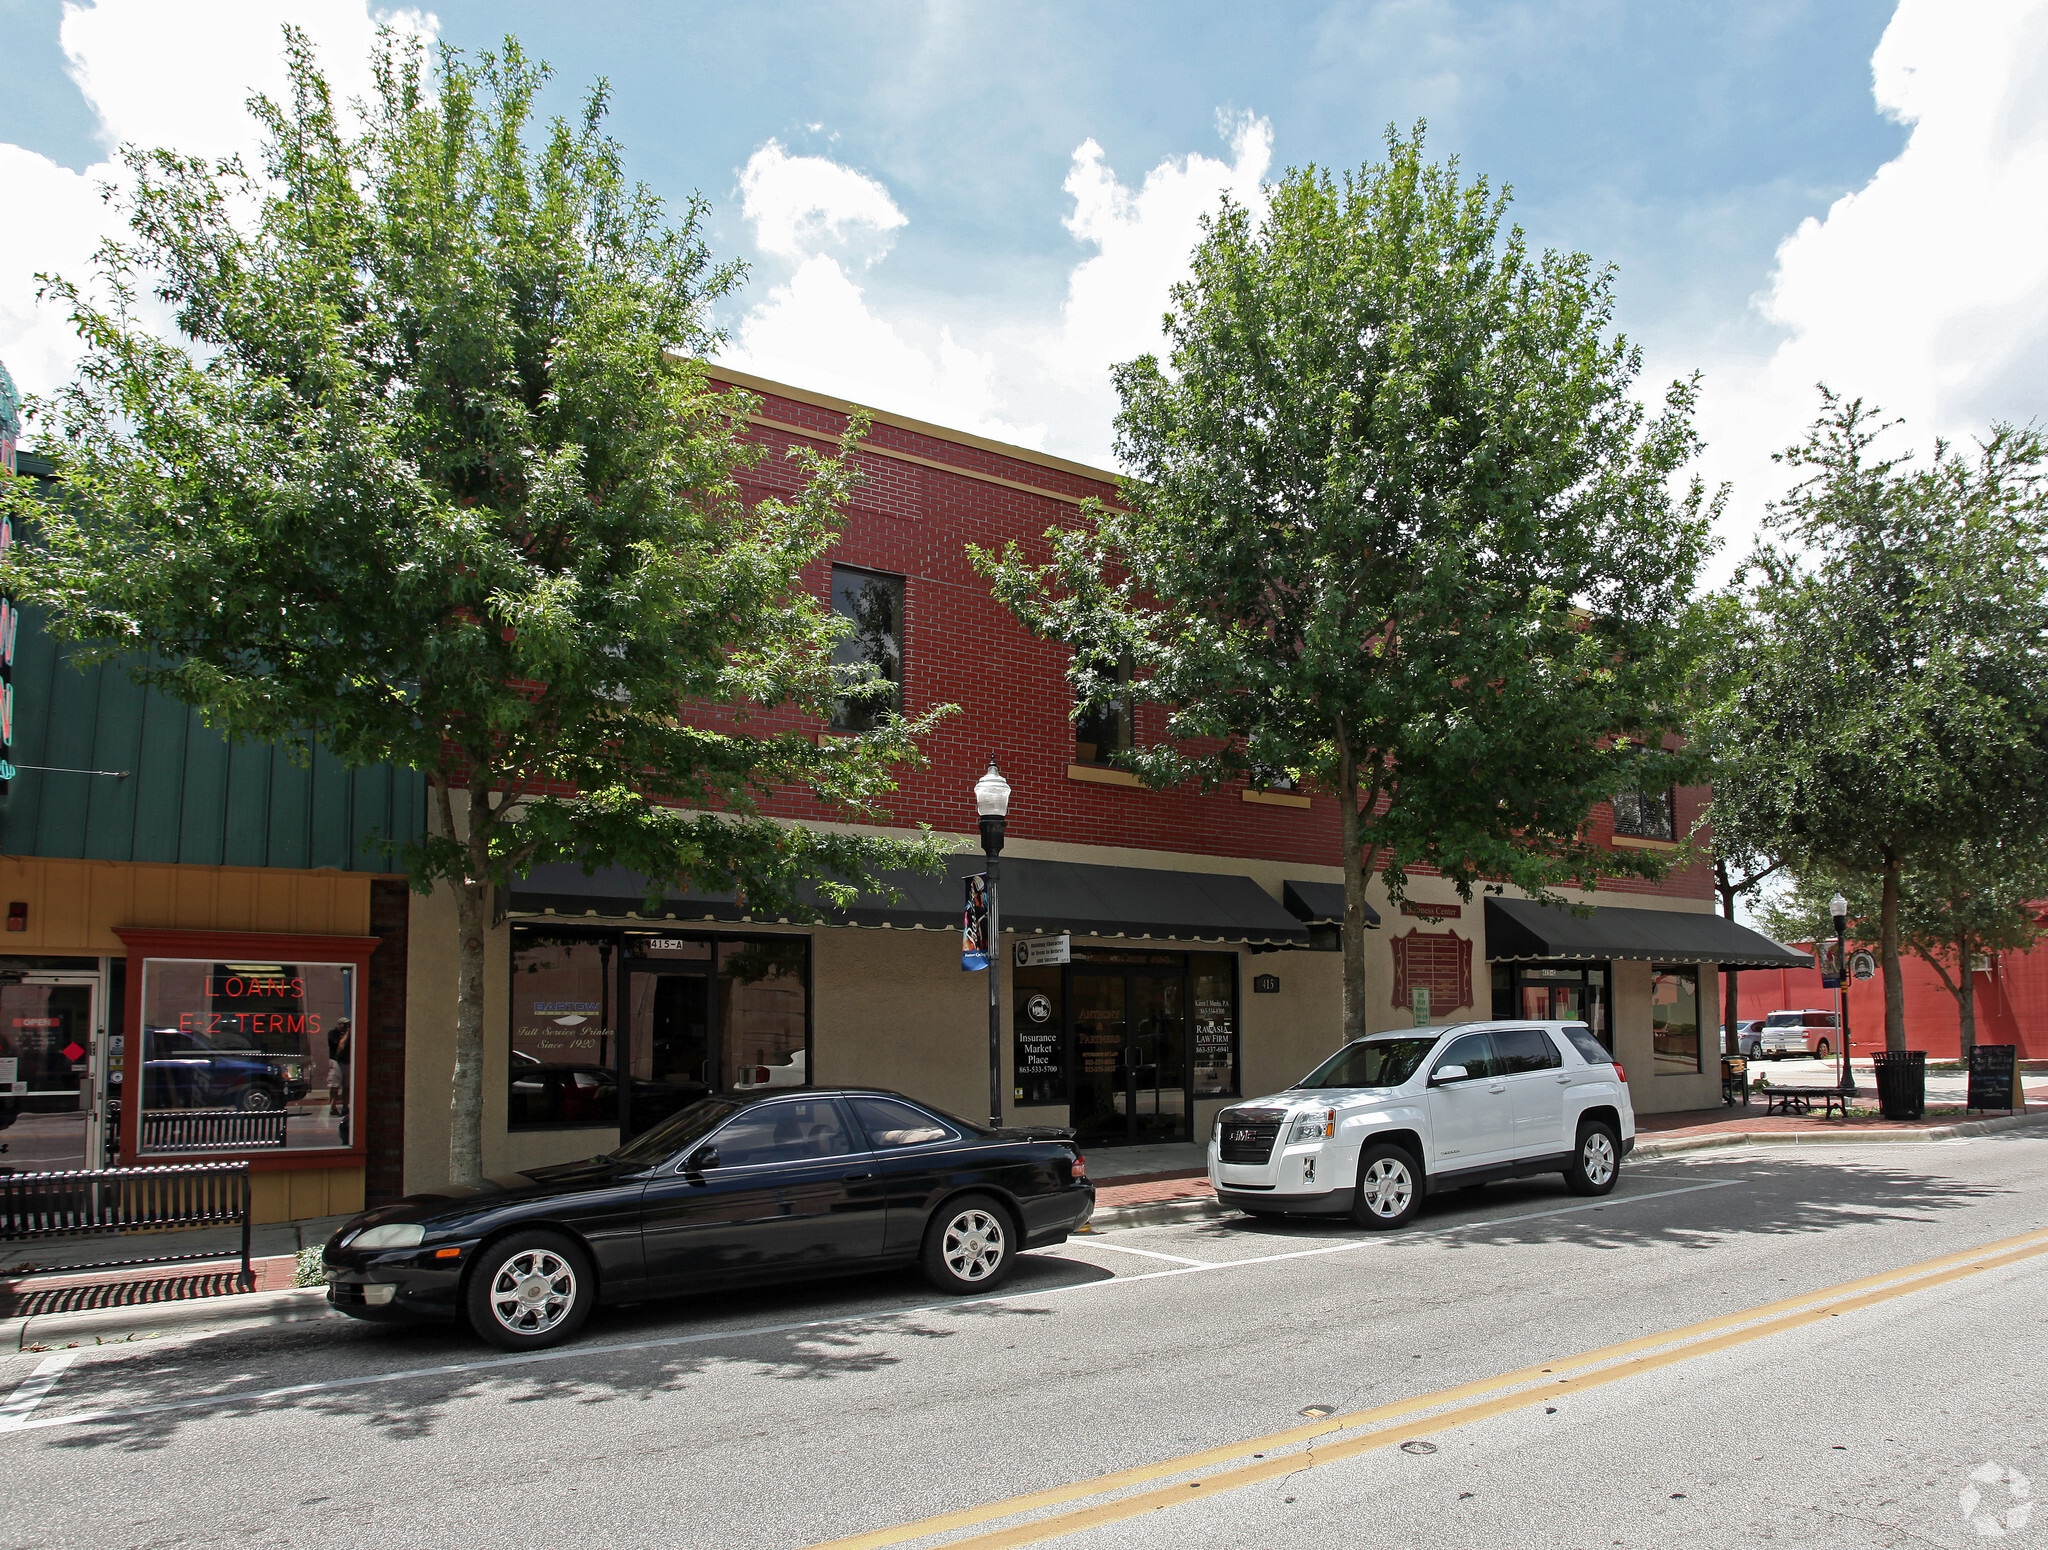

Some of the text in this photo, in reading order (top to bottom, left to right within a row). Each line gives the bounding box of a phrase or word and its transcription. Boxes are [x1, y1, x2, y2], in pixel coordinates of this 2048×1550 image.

[1435, 906, 1457, 915] Center
[651, 940, 682, 949] 415-A
[204, 977, 305, 998] LOANS
[533, 1001, 600, 1011] BARTOW
[179, 1013, 322, 1034] E-Z TERMS
[517, 1026, 616, 1036] Full Service Printer
[1196, 1025, 1228, 1034] RAWASIA
[1019, 1033, 1057, 1042] Insurance
[1196, 1035, 1212, 1043] LAW
[537, 1039, 596, 1049] Since 1920
[1024, 1044, 1052, 1054] Market
[1028, 1055, 1049, 1064] Place
[1018, 1065, 1058, 1074] 863-533-5700
